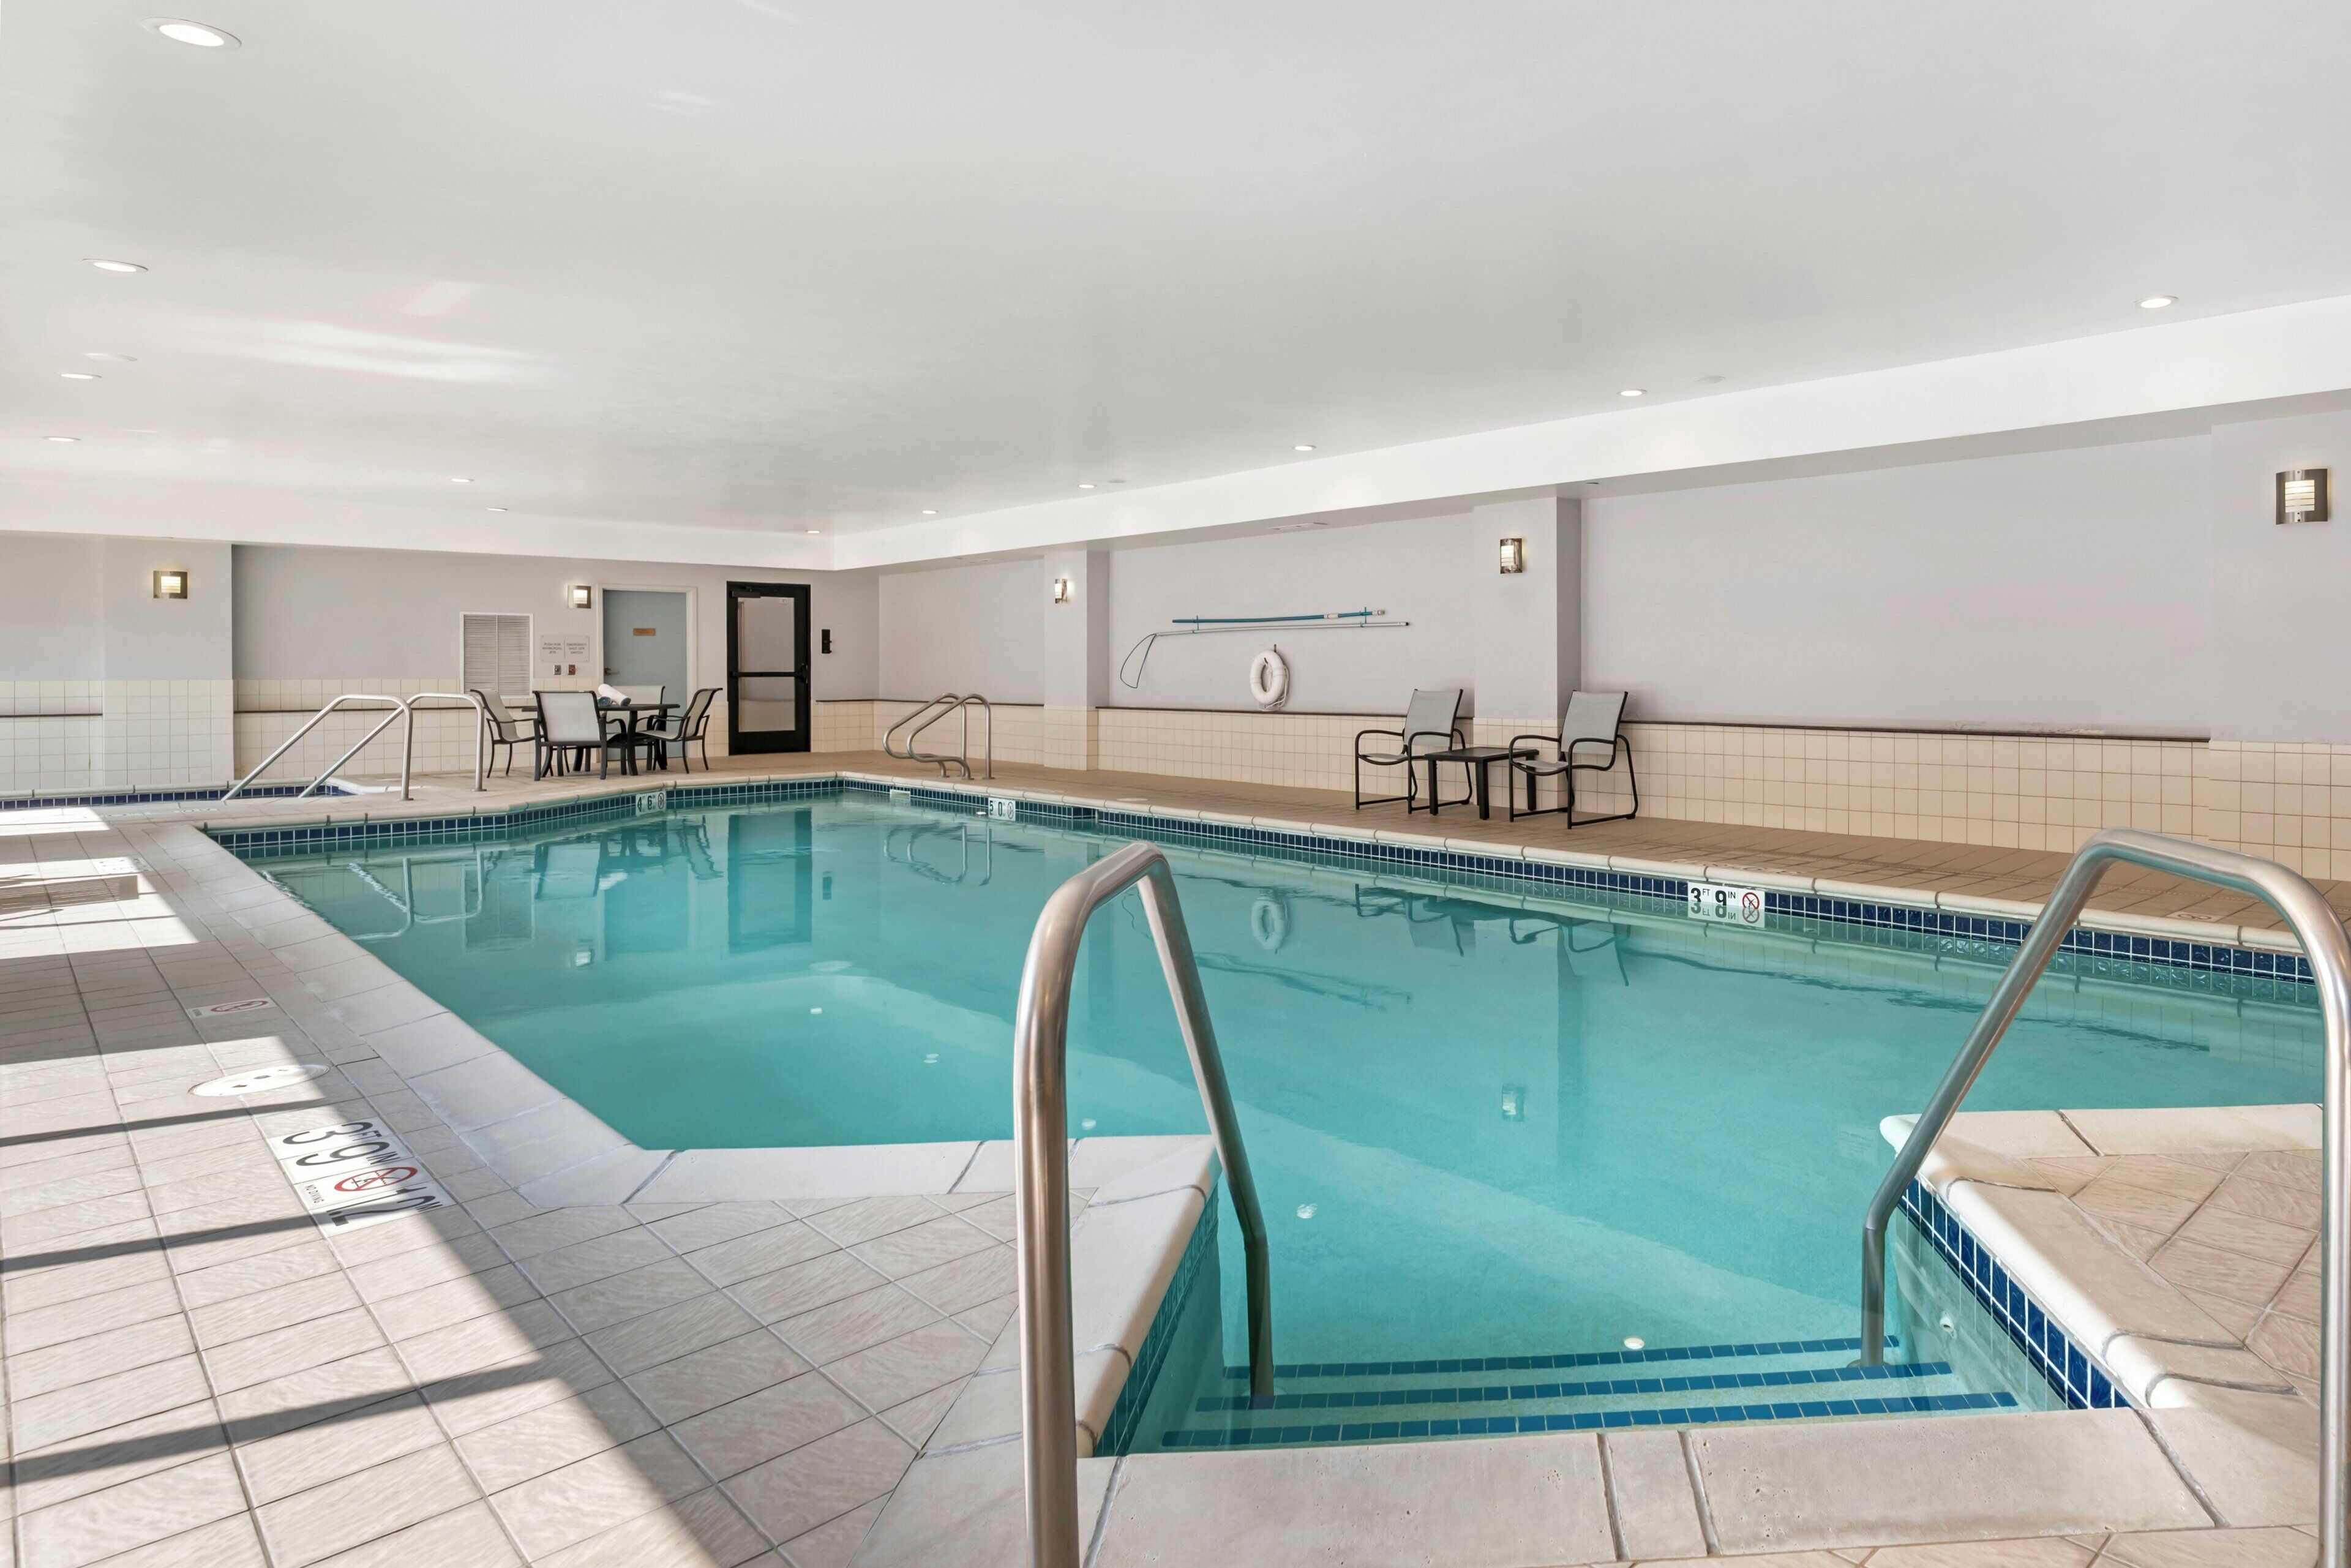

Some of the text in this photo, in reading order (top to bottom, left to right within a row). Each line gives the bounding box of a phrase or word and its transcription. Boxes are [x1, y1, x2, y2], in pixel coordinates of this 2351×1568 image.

[1690, 888, 1701, 902] 3
[1715, 890, 1727, 906] 9
[309, 1190, 324, 1203] DIVING
